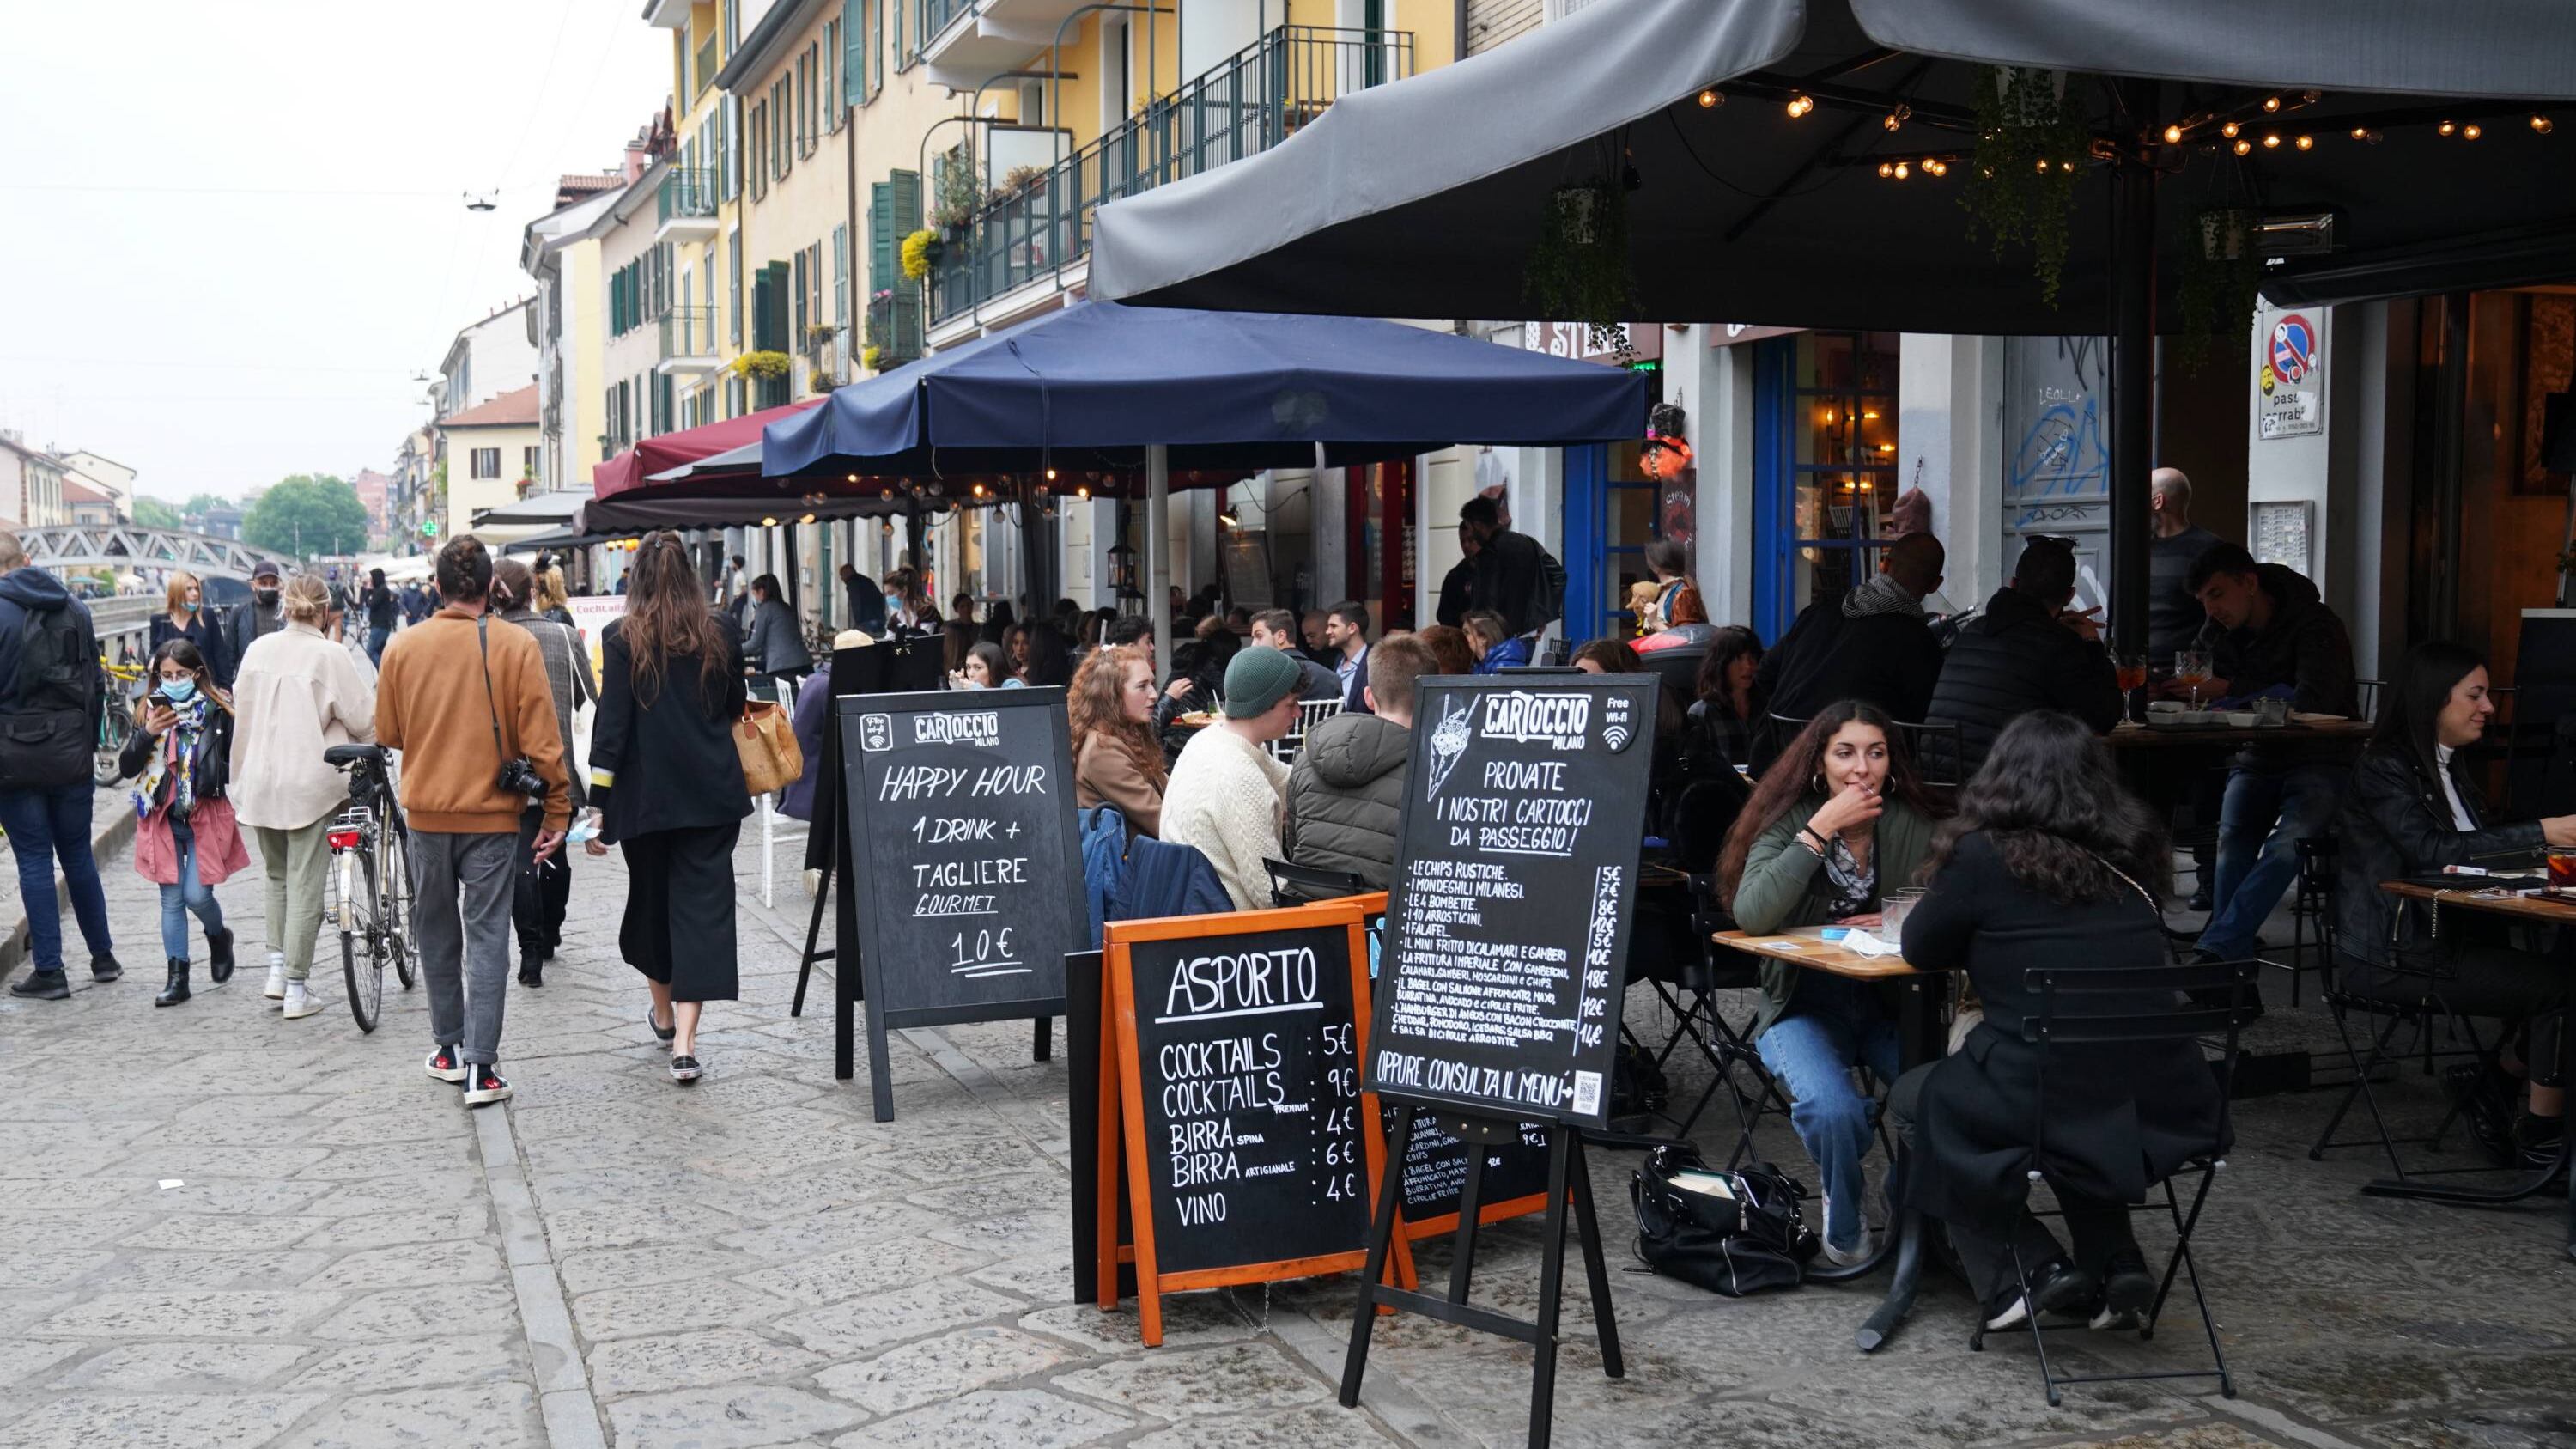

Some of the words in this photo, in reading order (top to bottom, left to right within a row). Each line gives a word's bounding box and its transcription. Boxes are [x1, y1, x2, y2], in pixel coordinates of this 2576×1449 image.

[1607, 697, 1629, 708] Free
[915, 712, 999, 745] CARTOCCIO
[1485, 691, 1589, 743] CARTOCCIO
[975, 737, 999, 746] MILANO
[1552, 735, 1585, 750] MILANO
[880, 765, 968, 801] HAPPY
[971, 765, 1045, 796] HOUR
[1484, 761, 1567, 791] PROVATE
[1437, 797, 1443, 820] I
[1449, 797, 1508, 822] NOSTRI
[1516, 799, 1592, 826] CARTOCCI
[912, 817, 926, 843] 1
[928, 819, 996, 843] DRINK
[1450, 826, 1471, 847] DA
[913, 858, 1028, 887] TAGLIERE
[1455, 861, 1508, 880] RUSTICHE.
[1602, 866, 1622, 882] 5€
[1411, 877, 1415, 891] I
[1416, 878, 1473, 895] MONDEGHILI
[1475, 881, 1524, 898] MILANESI.
[1599, 881, 1621, 898] 7€
[915, 894, 995, 915] GOURMET
[1408, 892, 1419, 907] LE
[1419, 894, 1426, 907] 4
[1428, 894, 1478, 910] BOMBETTE.
[1598, 899, 1617, 916] 8€
[1413, 908, 1424, 921] 10
[1425, 910, 1482, 927] ARROSTICINI.
[1592, 916, 1617, 933] 12€
[1411, 922, 1451, 937] FALAFEL.
[1593, 930, 1614, 947] 5€
[1402, 951, 1413, 963] LA
[1414, 952, 1453, 967] FRITTURA
[1454, 955, 1499, 971] IMPERIALE
[1503, 959, 1522, 973] CON
[1404, 936, 1413, 949] IL
[1414, 937, 1433, 951] MINI
[1436, 939, 1464, 953] FRITTO
[1521, 946, 1528, 959] E
[1528, 946, 1567, 962] GAMBERI
[1589, 948, 1612, 965] 10€
[1166, 947, 1316, 1014] ASPORTO
[1398, 977, 1406, 989] IL
[1407, 977, 1431, 991] BAGEL
[1432, 981, 1447, 993] CON
[1472, 971, 1518, 985] MOSCARDINI
[1586, 970, 1609, 988] 18€
[1480, 1000, 1511, 1012] CIPOLLE
[1583, 996, 1607, 1018] 12€
[1399, 1026, 1425, 1036] SALSA
[1485, 1013, 1502, 1023] CON
[1504, 1014, 1532, 1027] BACON
[1507, 1026, 1533, 1038] SALSA
[1534, 1030, 1553, 1042] BBQ
[1579, 1023, 1603, 1048] 14€
[1160, 1033, 1281, 1081] COCKTAILS
[1323, 1023, 1352, 1056] 5€
[1377, 1050, 1425, 1087] OPPURE
[1428, 1058, 1500, 1098] CONSULTA
[1502, 1071, 1514, 1099] IL
[1163, 1071, 1285, 1117] COCKTAILS
[1273, 1103, 1309, 1114] PREMIUM
[1327, 1068, 1356, 1098] 9€
[1170, 1118, 1234, 1155] BIRRA
[1237, 1134, 1264, 1145] SPINA
[1326, 1106, 1355, 1135] 4€
[1172, 1152, 1240, 1187] BIRRA
[1245, 1162, 1295, 1178] ARTIGIANALE
[1326, 1143, 1354, 1165] 6€
[1406, 1151, 1428, 1162] CHIPS
[1408, 1164, 1433, 1176] BAGEL
[1435, 1160, 1450, 1170] CON
[1176, 1192, 1226, 1227] VINO
[1326, 1173, 1355, 1202] 4€
